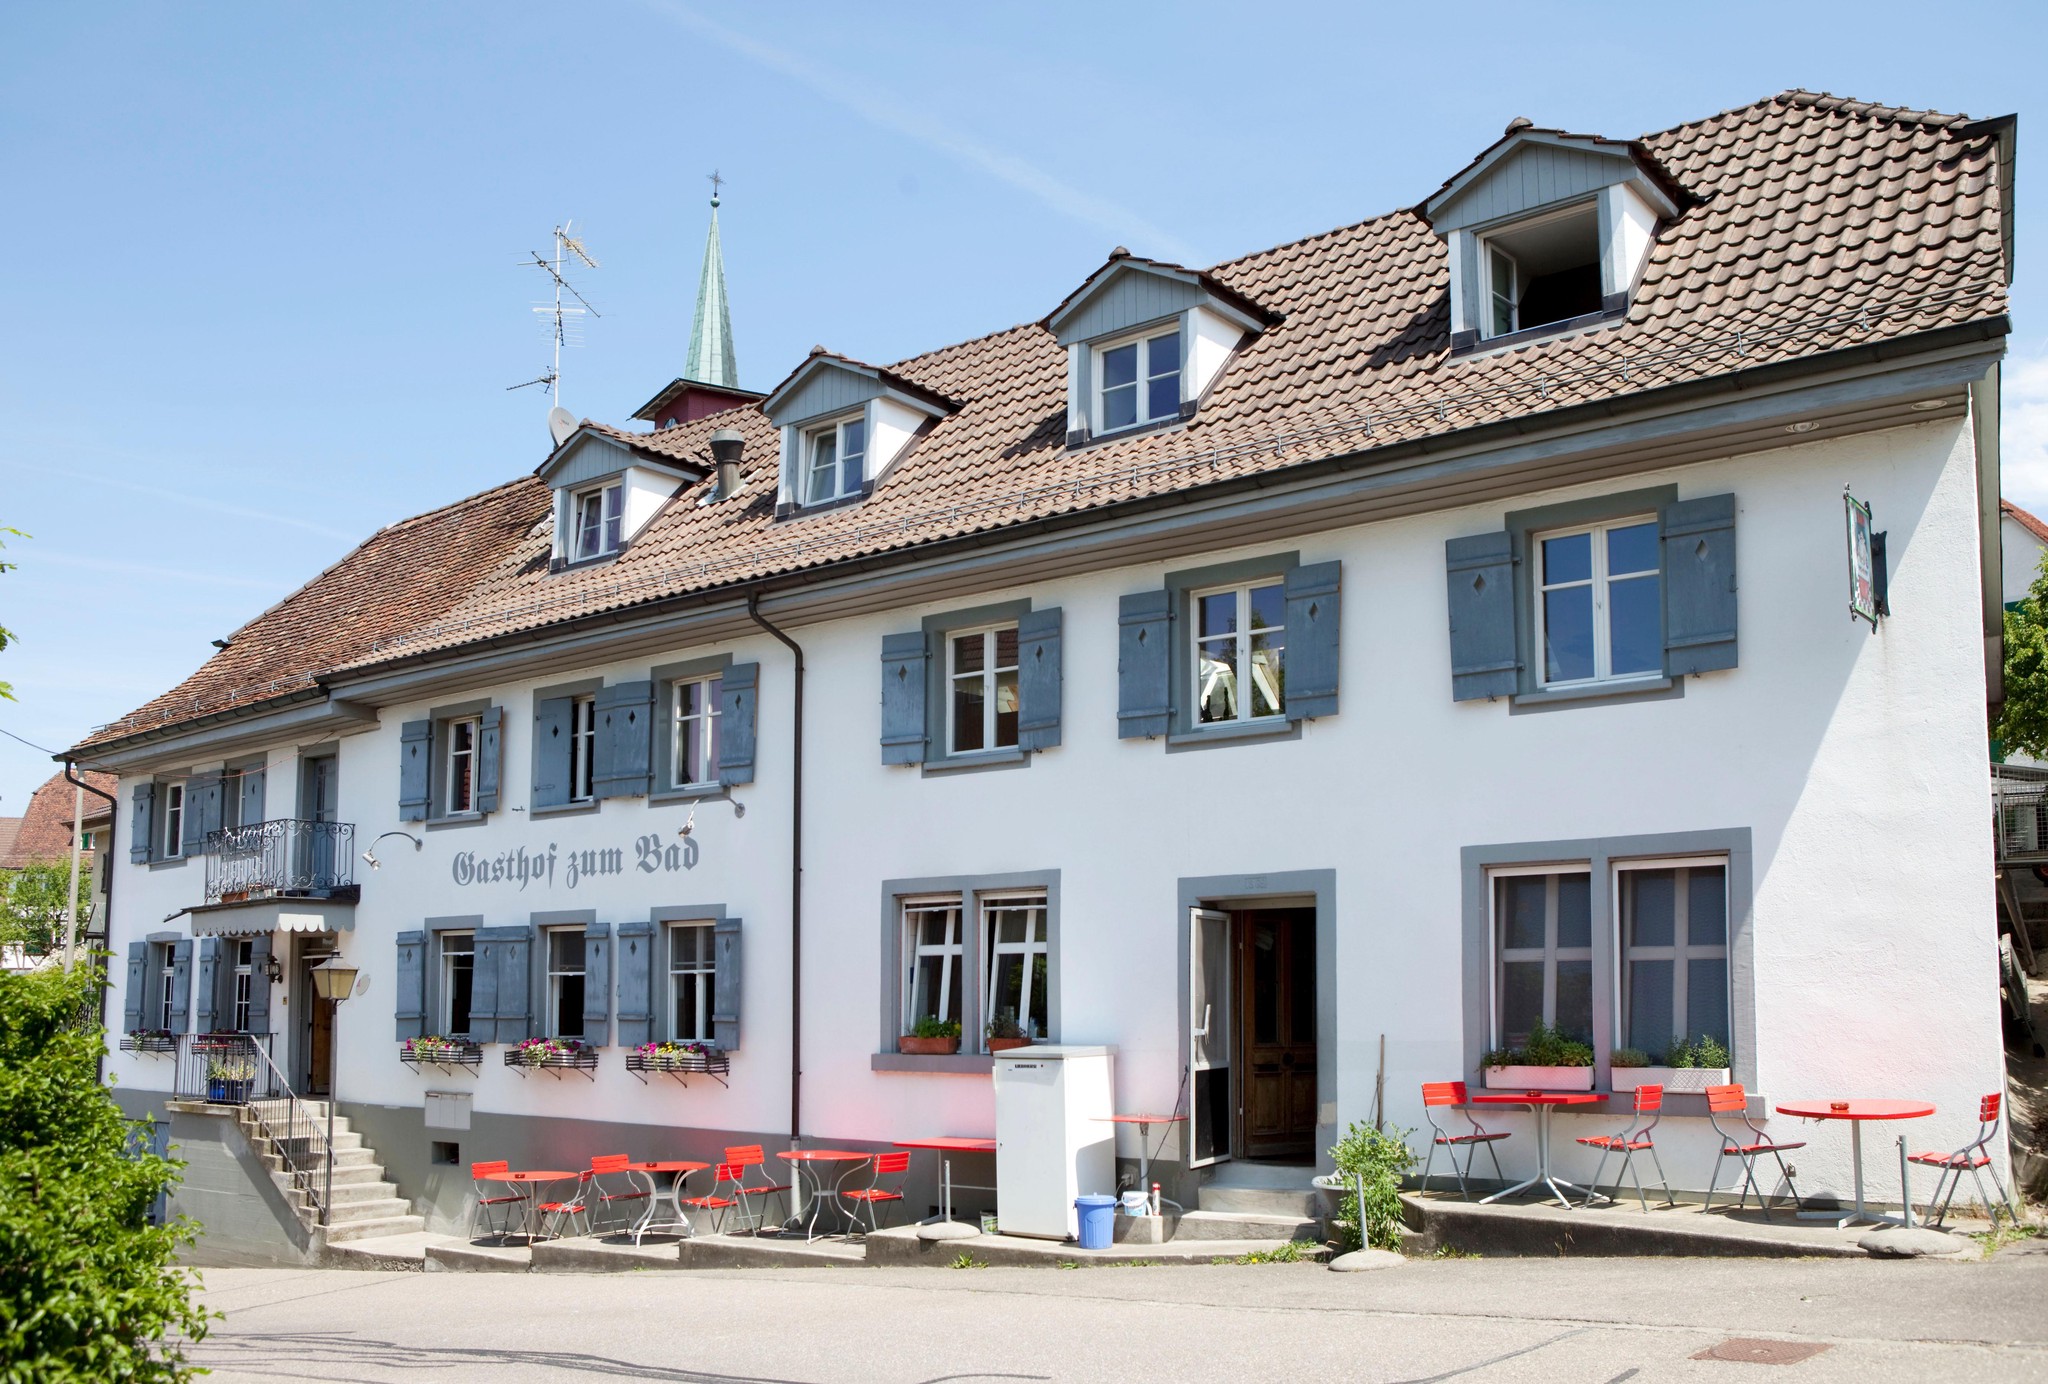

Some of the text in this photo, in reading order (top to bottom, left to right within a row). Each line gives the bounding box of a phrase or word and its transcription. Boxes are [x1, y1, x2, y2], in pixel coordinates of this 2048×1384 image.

[452, 833, 700, 892] Gasthof zum Bad
